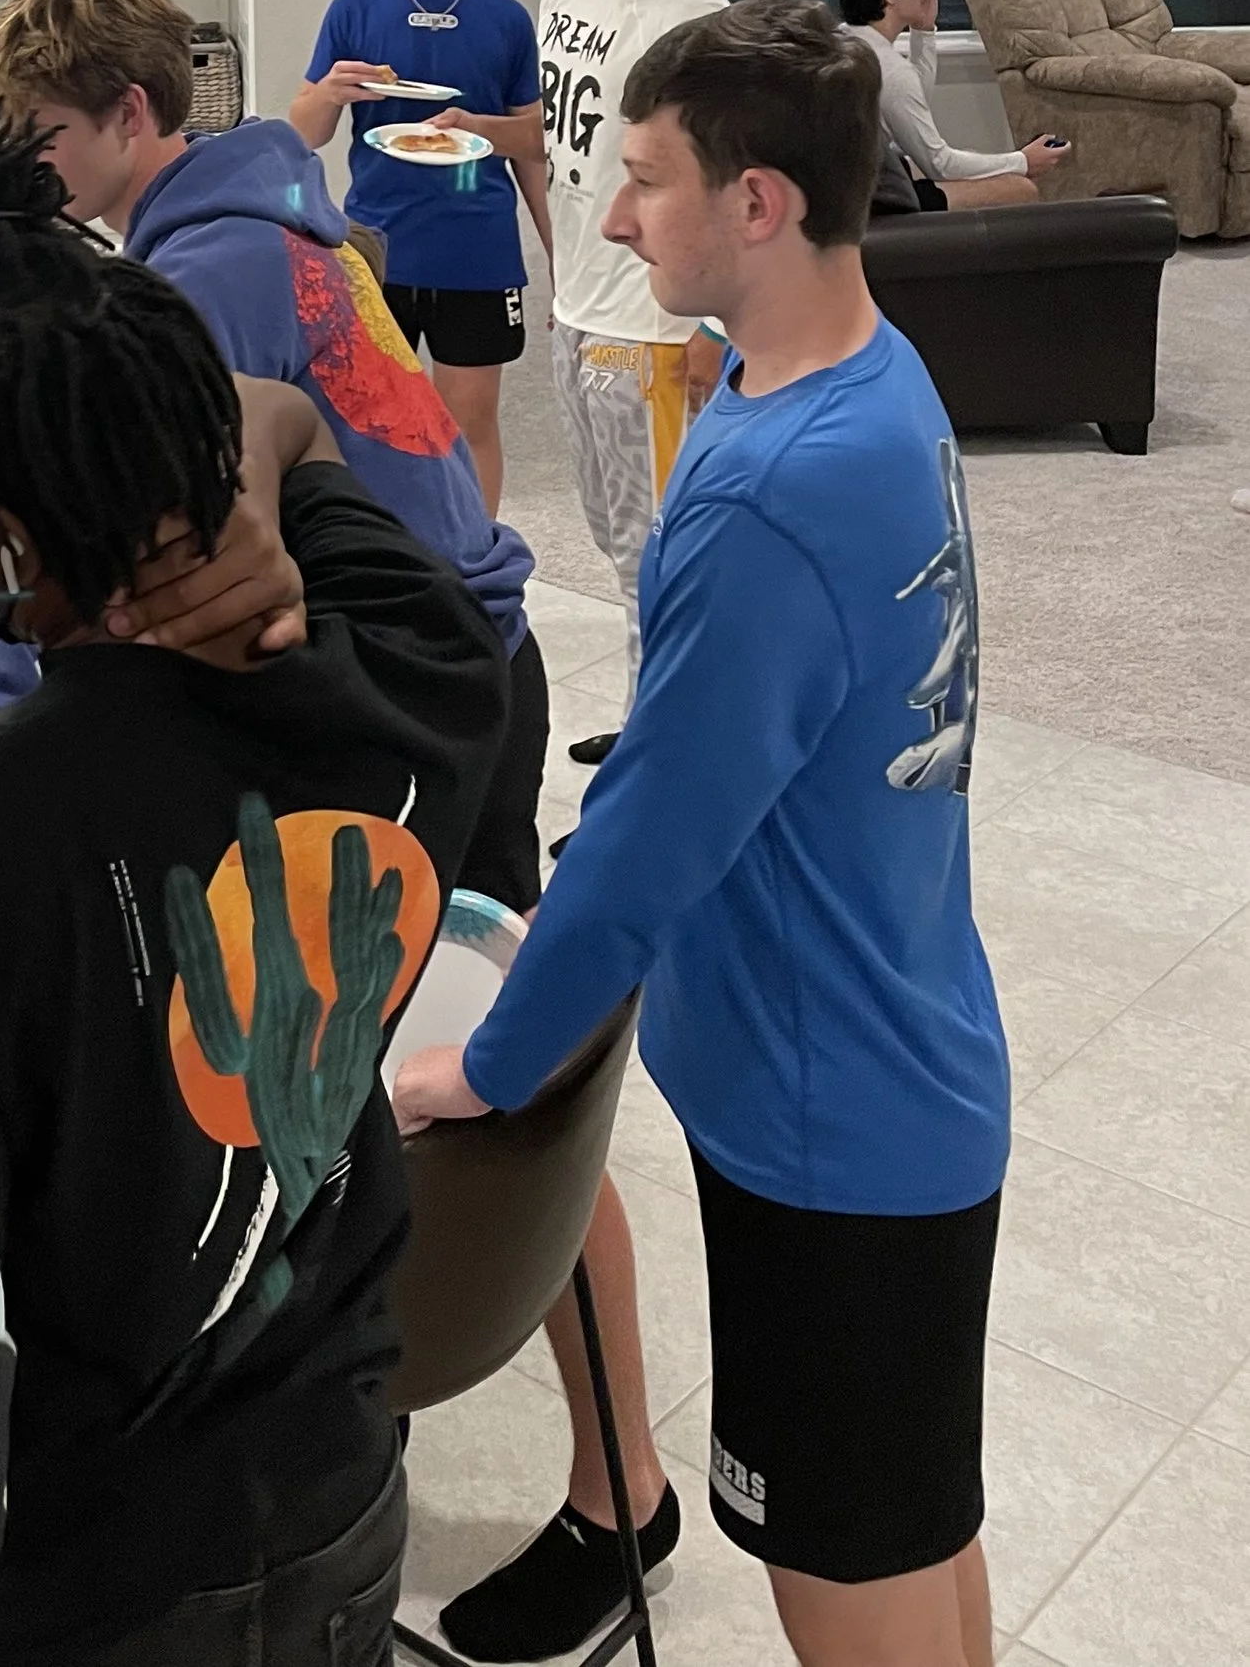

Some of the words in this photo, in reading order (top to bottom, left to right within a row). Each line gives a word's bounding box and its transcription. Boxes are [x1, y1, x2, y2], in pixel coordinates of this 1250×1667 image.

[542, 12, 617, 65] DREAM
[541, 61, 605, 157] BIG
[585, 367, 615, 392] 77
